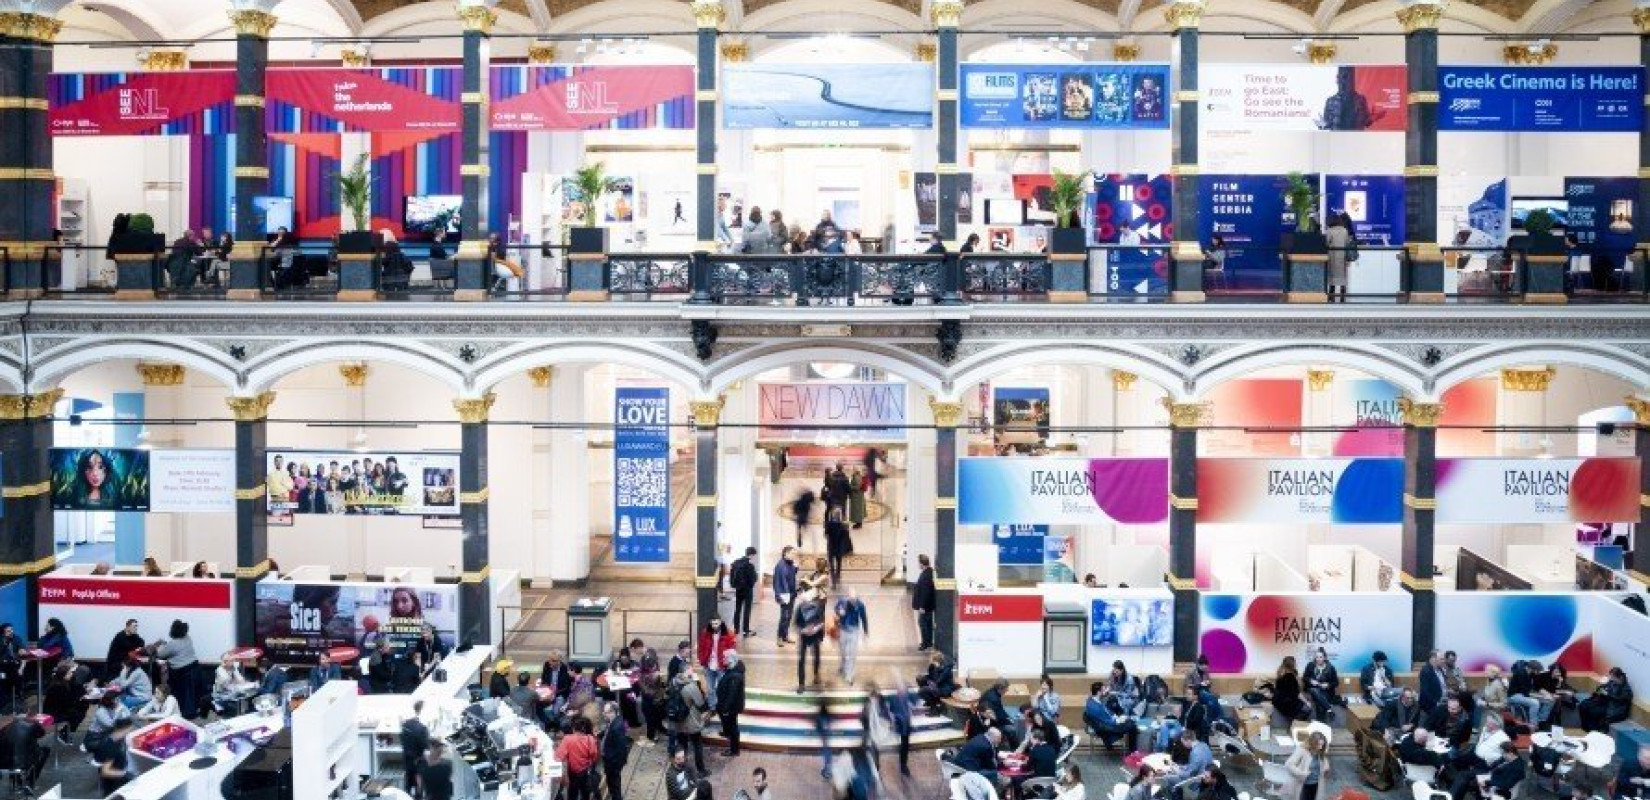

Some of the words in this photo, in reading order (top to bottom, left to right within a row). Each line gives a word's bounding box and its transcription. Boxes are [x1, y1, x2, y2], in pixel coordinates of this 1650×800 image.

[1244, 74, 1272, 84] Time
[1274, 74, 1288, 84] to
[1443, 73, 1496, 88] Greek
[1499, 73, 1567, 90] Cinema
[1571, 74, 1585, 89] is
[1590, 74, 1638, 90] Here!
[567, 83, 578, 110] SEE
[578, 82, 618, 111] NL
[1244, 87, 1260, 98] go
[1262, 85, 1289, 95] East:
[120, 89, 130, 115] SEE
[131, 88, 168, 115] NL
[333, 101, 393, 111] netherlands
[1244, 97, 1260, 107] Go
[1262, 98, 1282, 107] see
[1284, 96, 1304, 107] the
[1213, 183, 1238, 191] FILM
[1212, 194, 1254, 203] CENTER
[1213, 205, 1252, 214] SERBIA
[761, 386, 821, 420] NEW
[828, 386, 904, 420] DAWN
[618, 407, 666, 424] LOVE
[1031, 470, 1097, 484] ITALIAN
[1268, 470, 1333, 484] ITALIAN
[1505, 470, 1569, 484] ITALIAN
[1031, 484, 1097, 496] PAVILION
[1268, 484, 1333, 496] PAVILION
[1505, 484, 1569, 496] PAVILION
[635, 516, 657, 531] LUX
[72, 589, 95, 600] PopUp
[96, 589, 121, 600] Offices
[291, 600, 322, 631] Sica
[1275, 617, 1341, 631] ITALIAN
[1275, 631, 1341, 643] PAVILION
